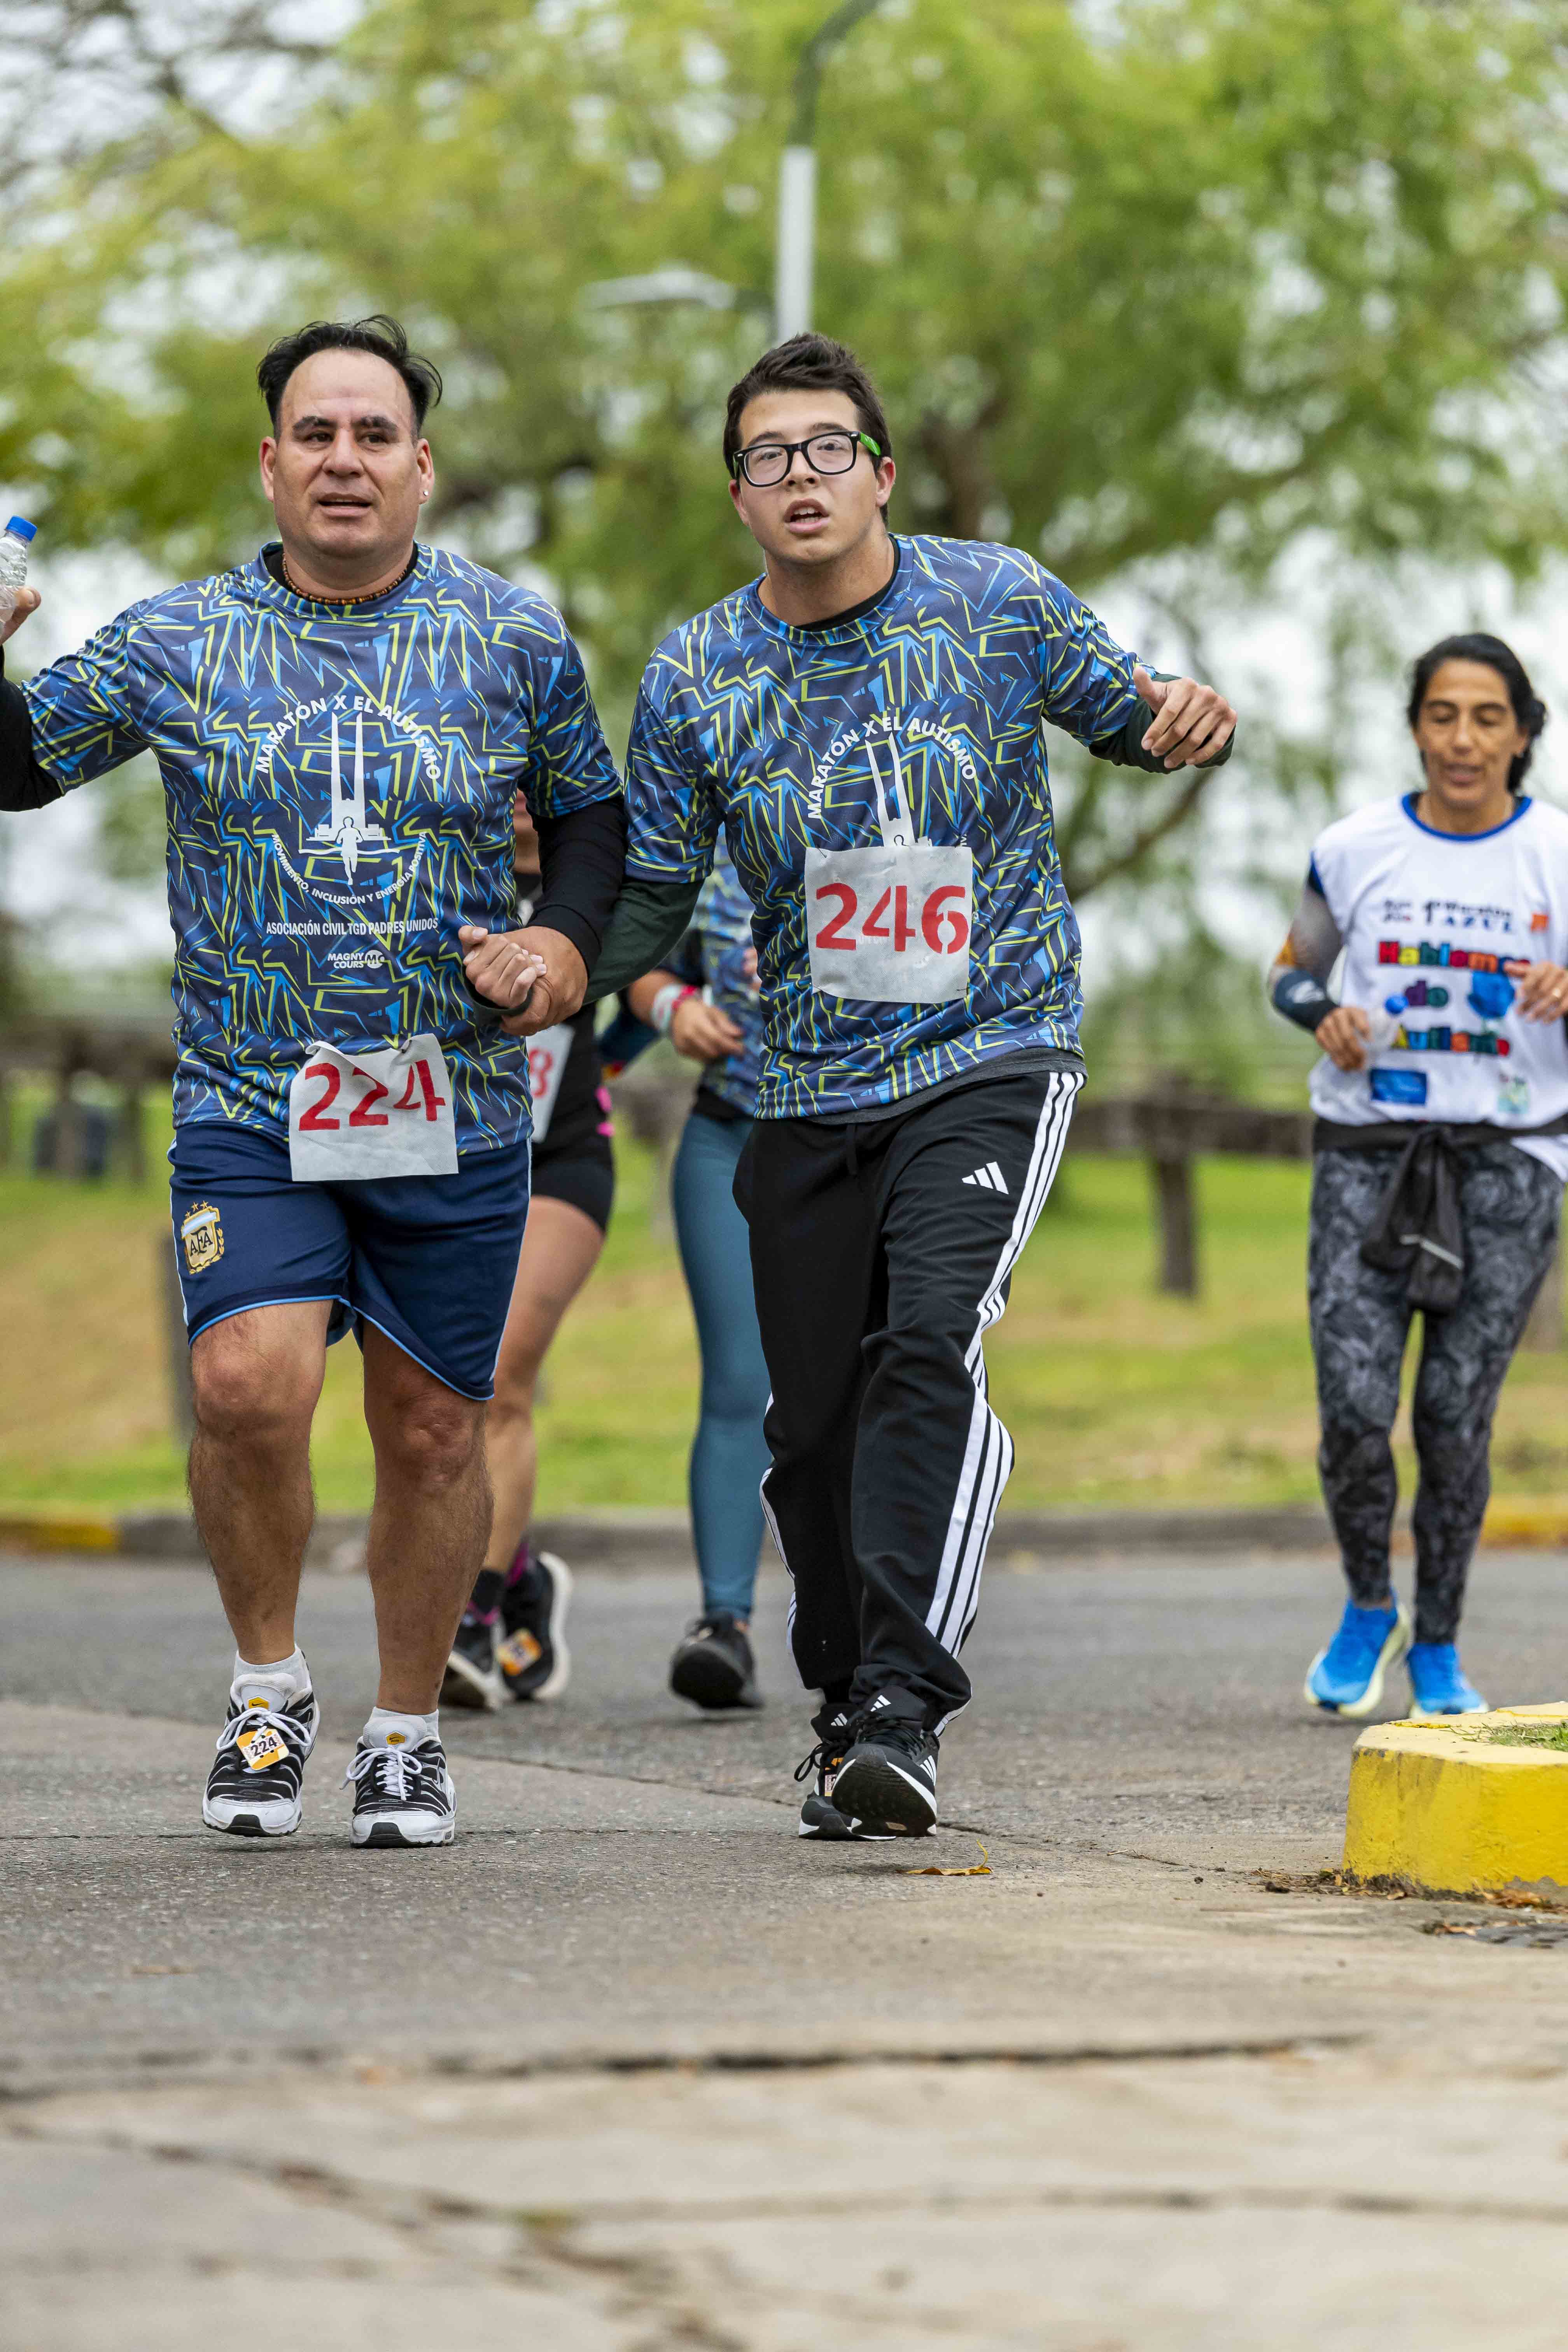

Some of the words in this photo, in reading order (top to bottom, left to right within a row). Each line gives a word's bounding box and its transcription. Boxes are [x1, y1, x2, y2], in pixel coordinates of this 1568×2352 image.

[256, 698, 327, 774] MARATÓN
[333, 695, 347, 710] X
[354, 696, 374, 714] EL
[378, 705, 441, 779] AUTISMO
[807, 729, 861, 819] MARATÓN
[862, 720, 878, 737] X
[883, 716, 903, 732] EL
[907, 718, 976, 780] AUTISMO
[271, 833, 309, 892] MOVIMIENTO,
[312, 888, 366, 905] INCLUSIÓN
[367, 894, 373, 902] Y
[375, 872, 414, 900] ENERGÍA
[409, 832, 427, 873] POSITIVA
[266, 920, 320, 935] ASOCIACIÓN
[322, 923, 346, 935] CIVIL
[348, 923, 366, 935] TGD
[368, 921, 404, 934] PADRES
[406, 918, 439, 932] UNIDOS
[816, 882, 969, 954] 246
[327, 953, 364, 961] MAGNY
[333, 960, 364, 969] COURS
[299, 1059, 446, 1131] 224
[190, 1226, 213, 1256] AFA
[251, 1737, 277, 1756] 224
